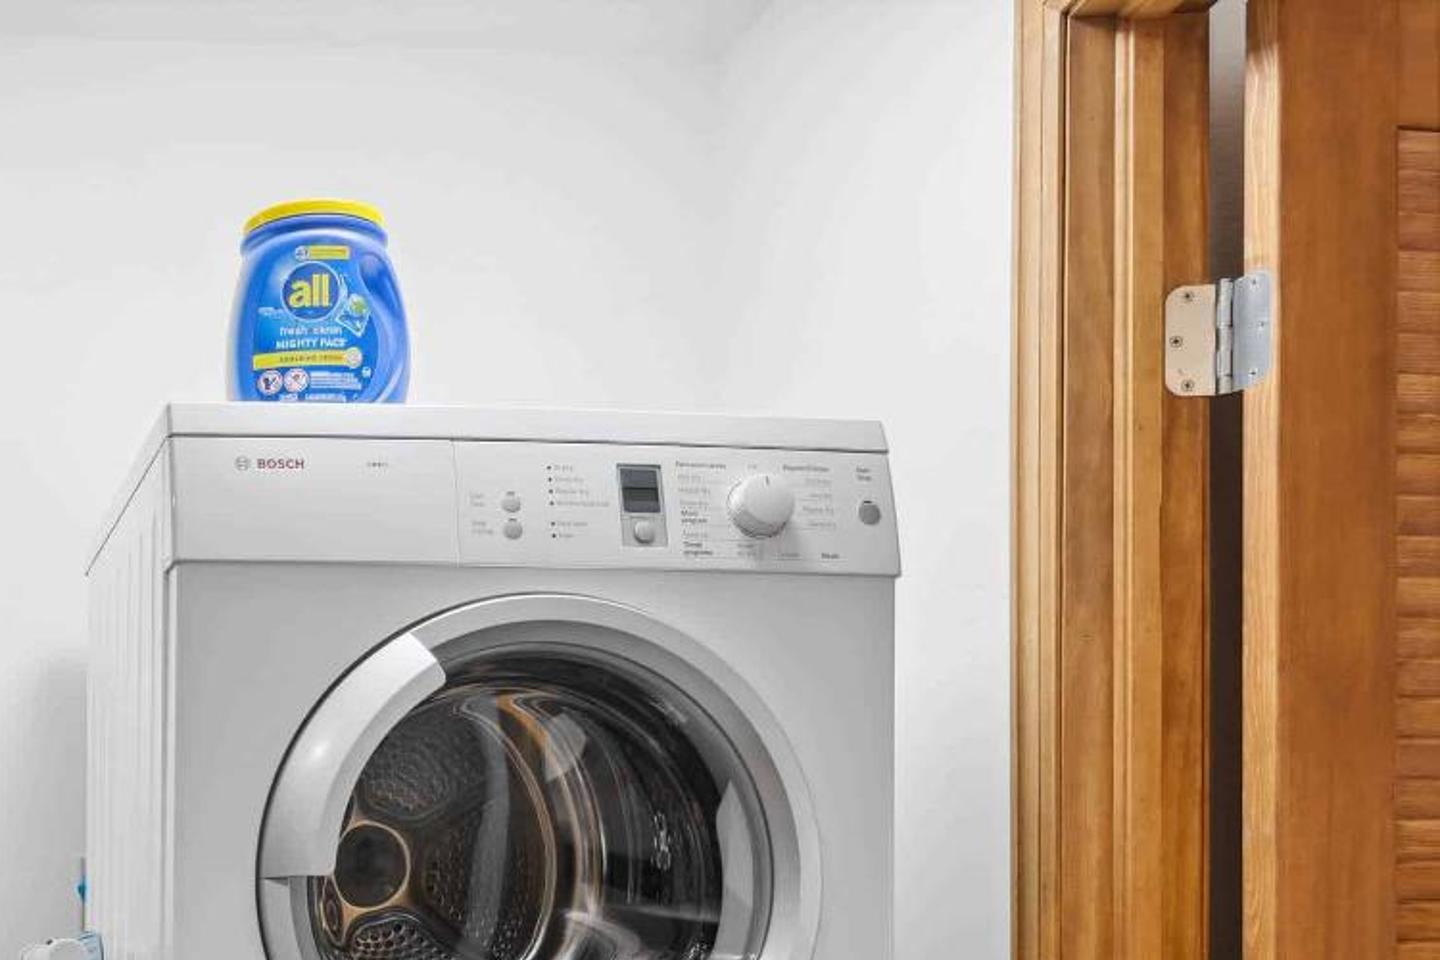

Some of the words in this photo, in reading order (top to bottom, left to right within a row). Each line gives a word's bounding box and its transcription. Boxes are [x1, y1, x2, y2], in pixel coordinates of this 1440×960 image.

[289, 273, 330, 307] all
[275, 338, 318, 350] MIGHTY
[256, 458, 305, 470] BOSCH
